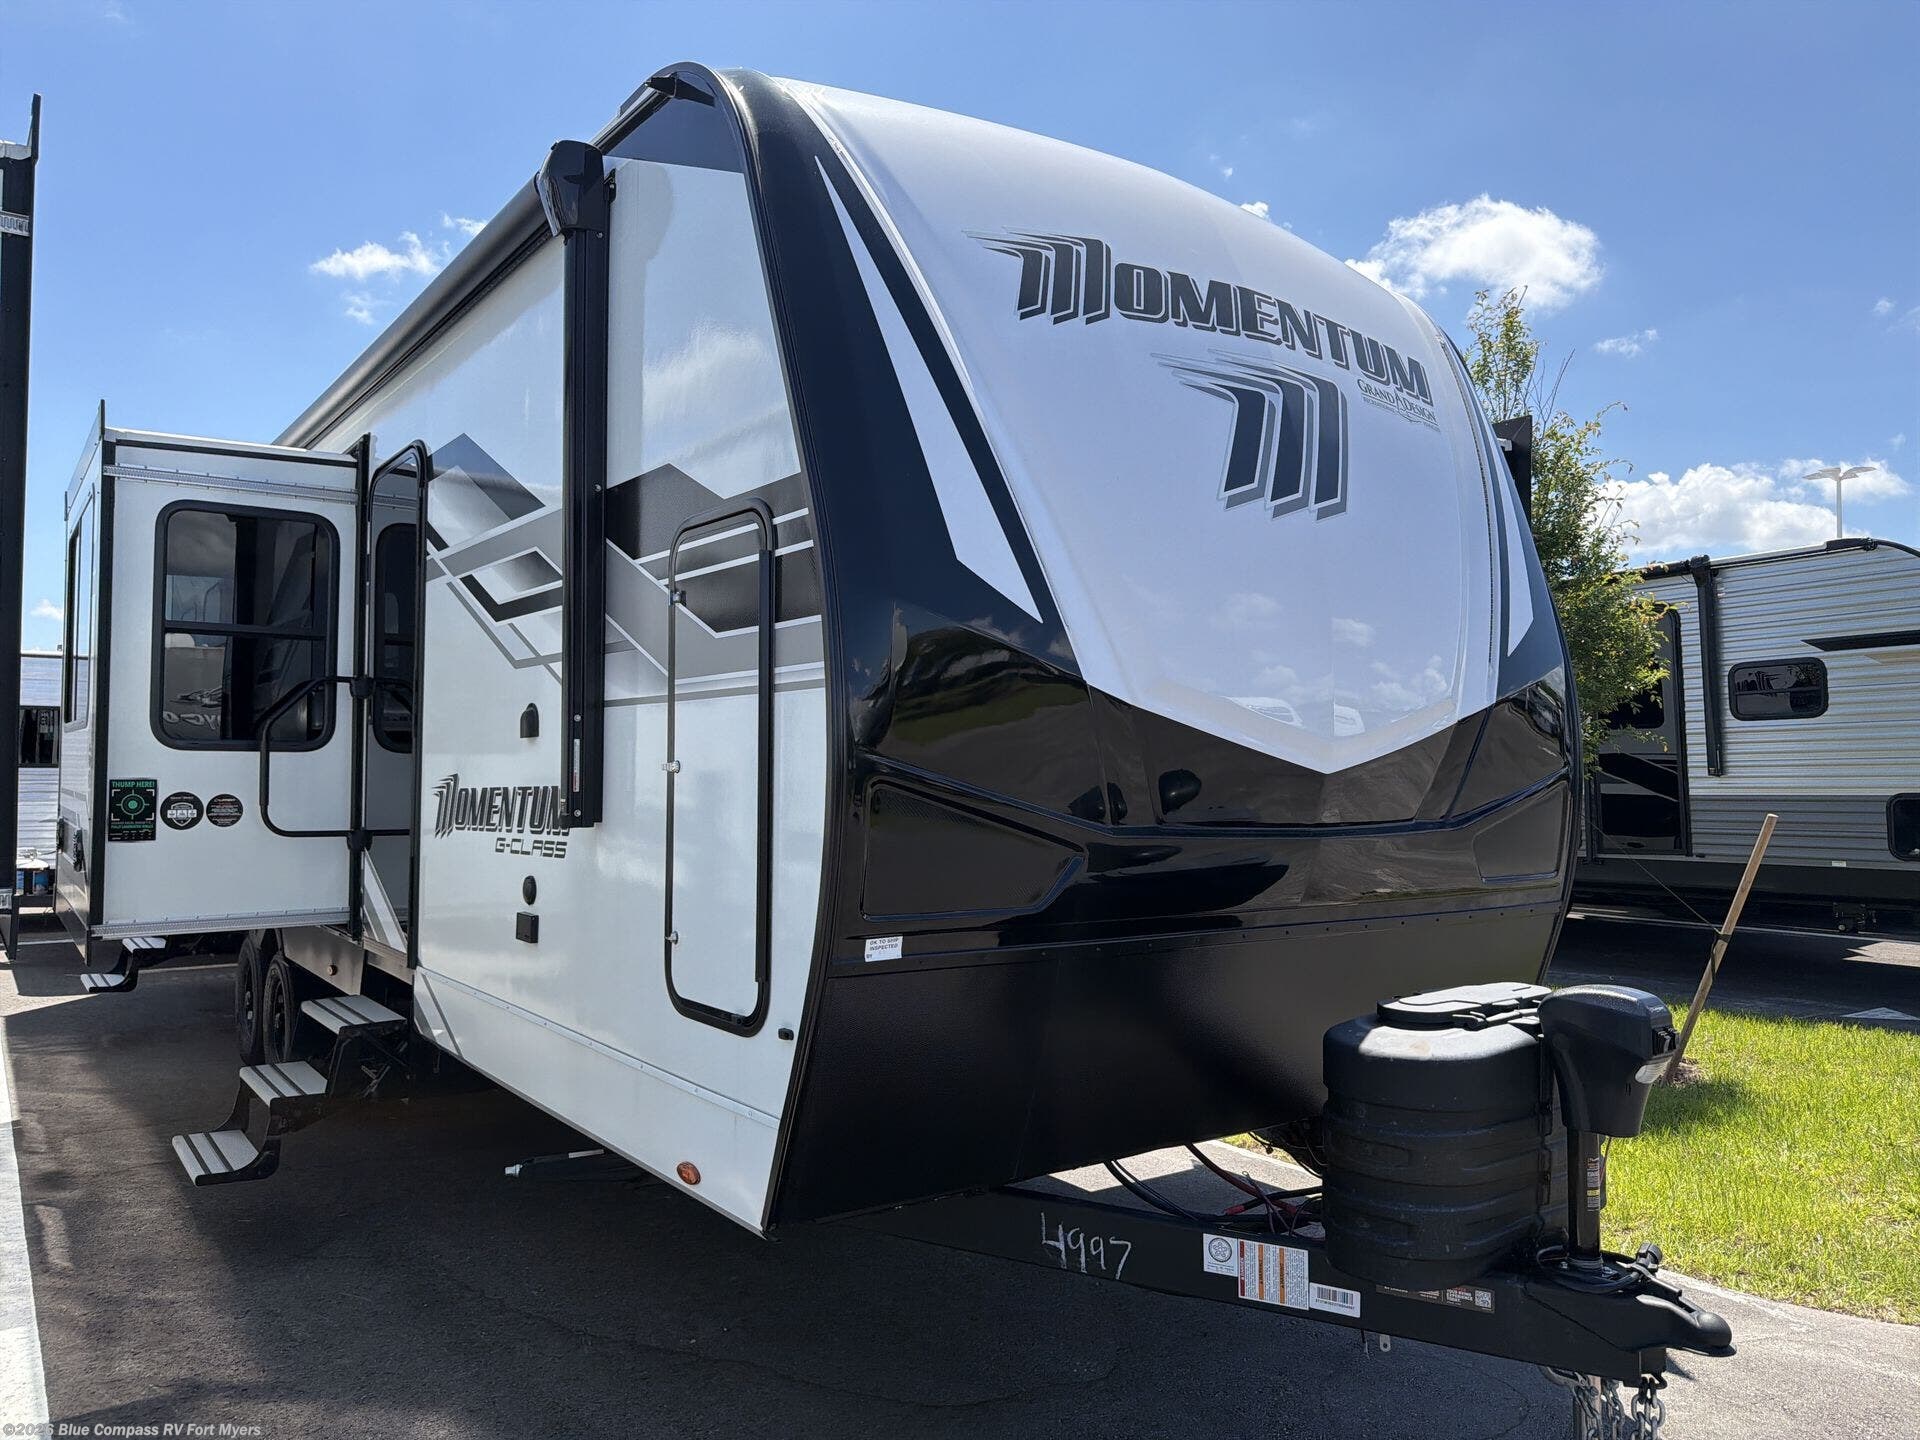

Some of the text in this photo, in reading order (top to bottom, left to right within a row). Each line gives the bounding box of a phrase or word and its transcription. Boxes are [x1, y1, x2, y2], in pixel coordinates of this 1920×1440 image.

[962, 227, 1434, 407] MOMENTUM
[1357, 379, 1395, 404] GRAND
[1401, 397, 1437, 423] DESIGN
[495, 837, 567, 859] G-CLASS
[1041, 1211, 1132, 1280] 4997
